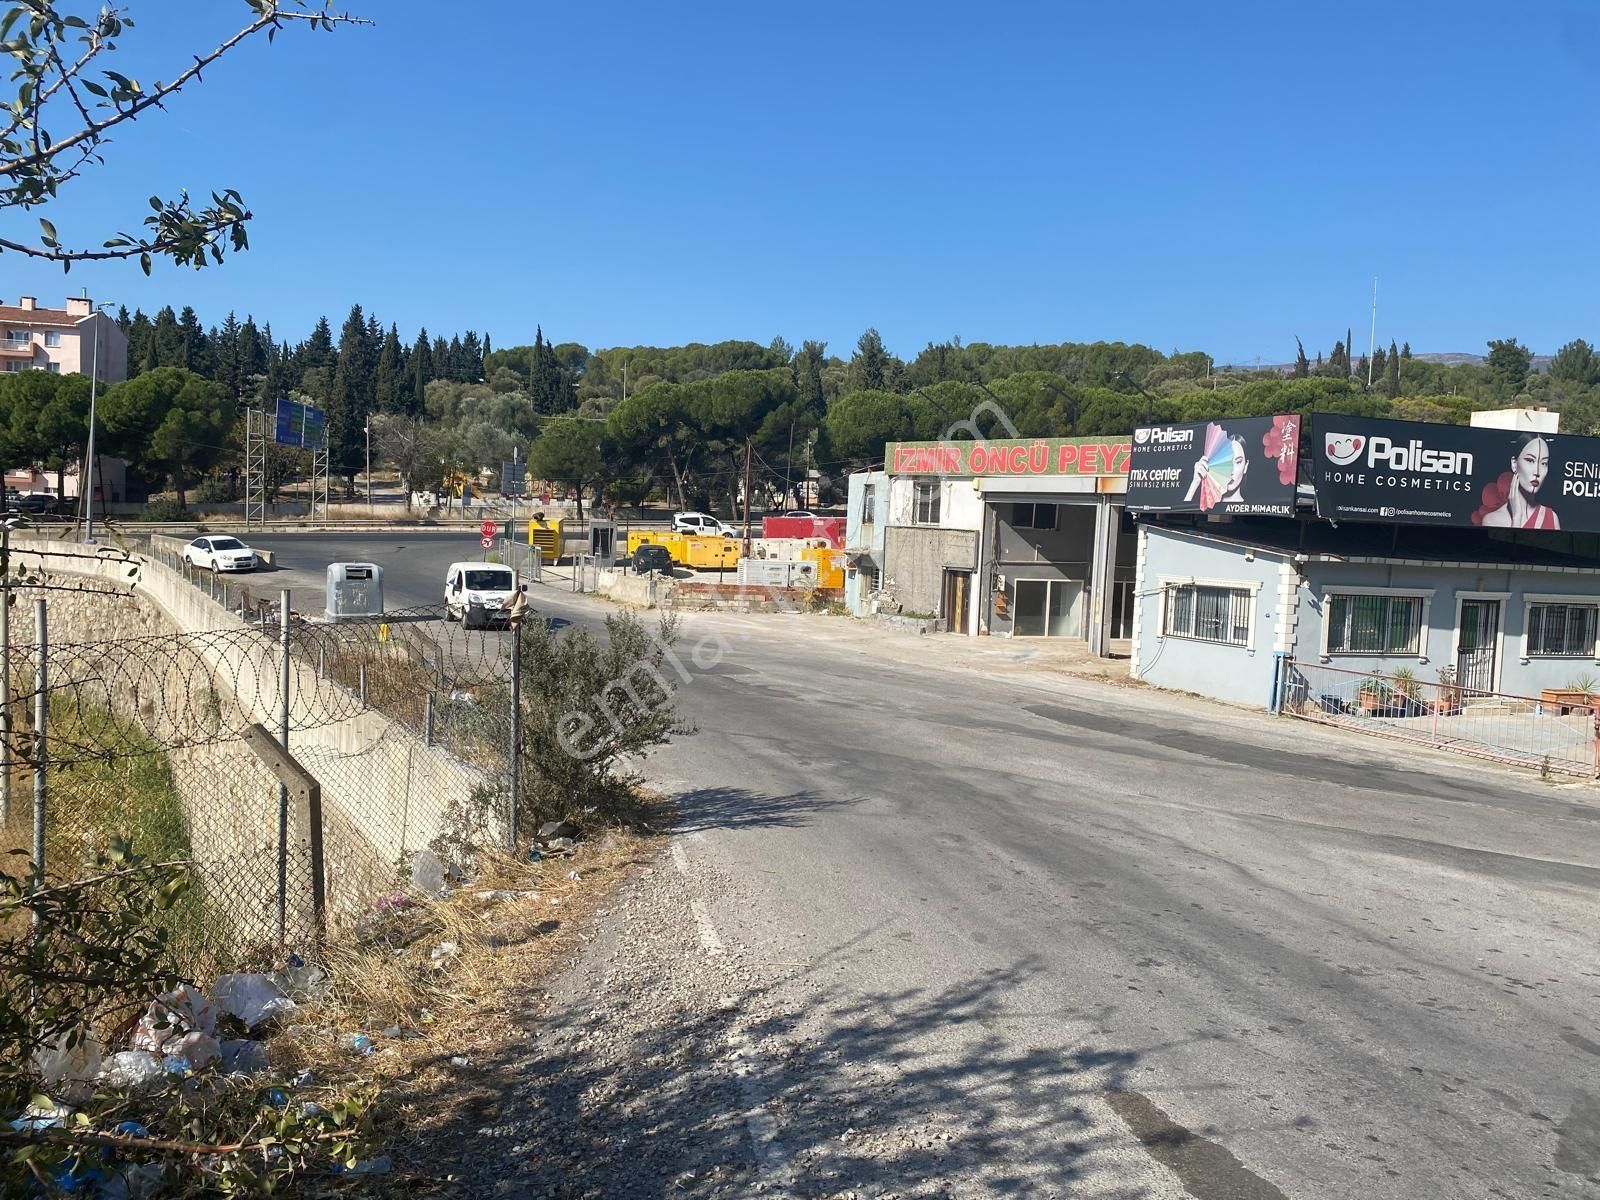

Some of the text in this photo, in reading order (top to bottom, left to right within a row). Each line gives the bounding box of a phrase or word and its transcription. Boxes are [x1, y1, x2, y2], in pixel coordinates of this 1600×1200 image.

[1150, 427, 1194, 443] Polisan
[893, 442, 962, 473] İZMİR
[968, 440, 1049, 473] ÖNCÜ
[1153, 444, 1192, 452] COSMETICS
[1368, 436, 1473, 476] Polisan
[1130, 467, 1182, 480] mix center
[1564, 461, 1600, 479] SENi
[1325, 471, 1472, 492] HOME COSMETICS
[1563, 480, 1600, 498] POLi
[1225, 504, 1249, 512] AYDER
[1336, 505, 1379, 514] olisankansai.com
